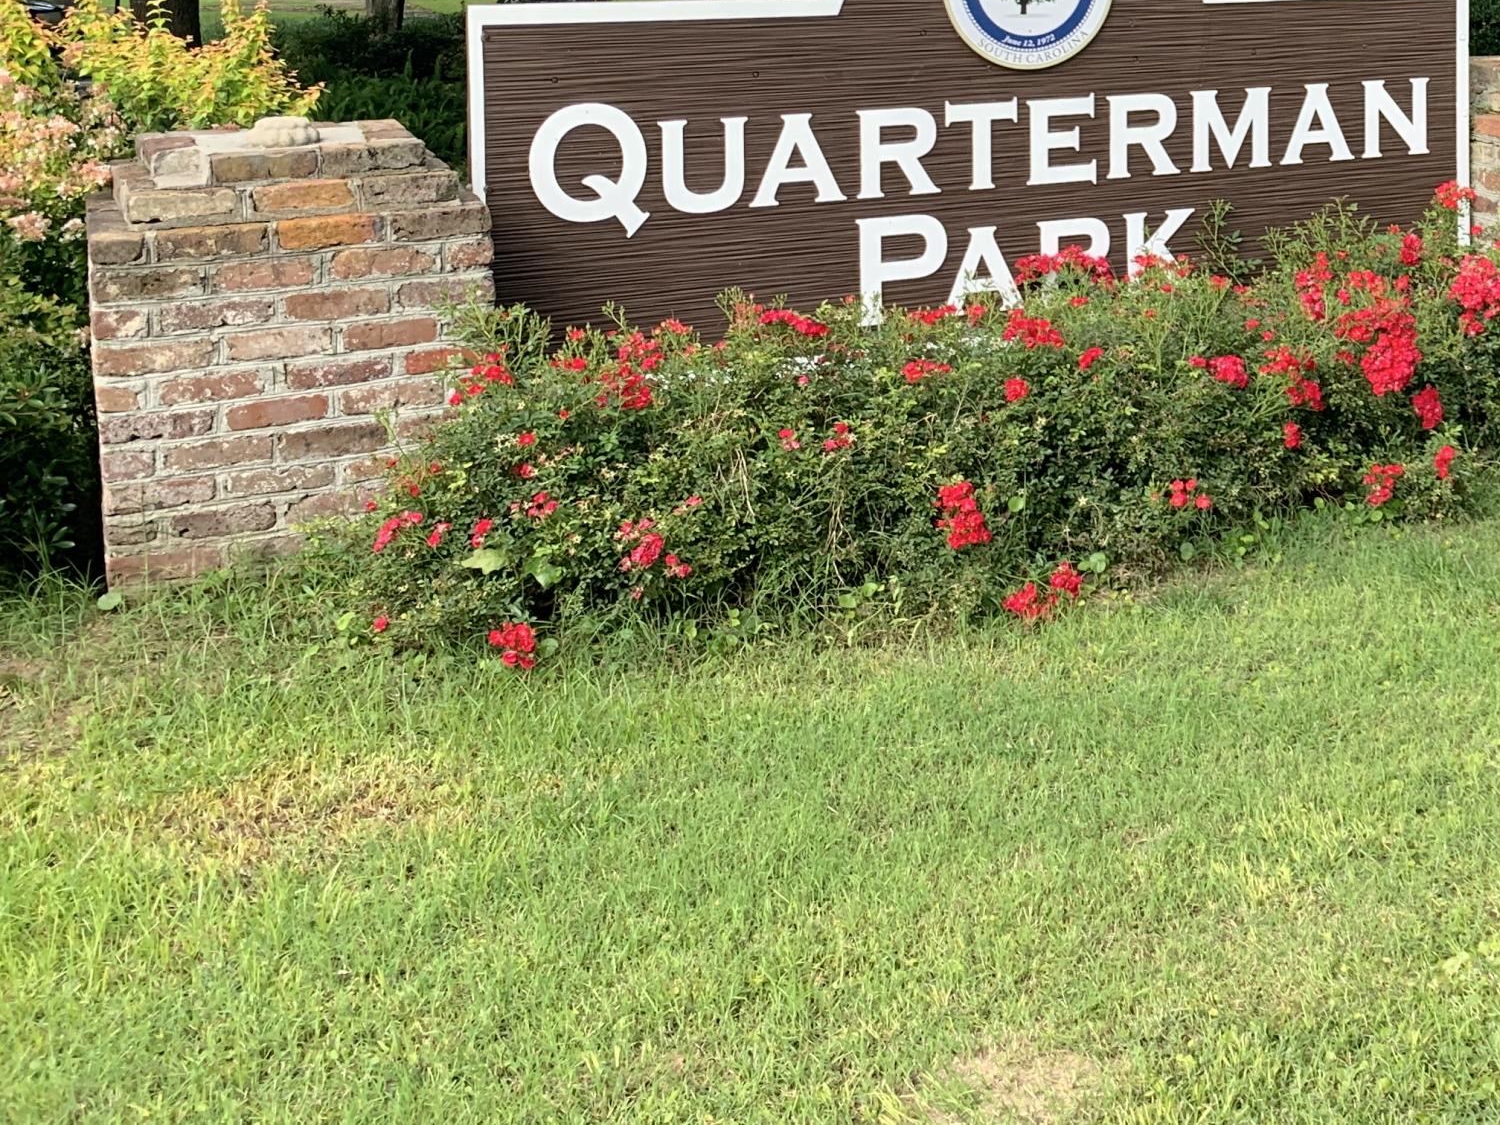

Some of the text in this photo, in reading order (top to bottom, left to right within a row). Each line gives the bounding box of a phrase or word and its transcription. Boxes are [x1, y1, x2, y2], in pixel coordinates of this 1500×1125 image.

[978, 30, 1088, 63] SOUTH CAROLINA
[1002, 35, 1021, 46] June
[1037, 34, 1056, 46] 1972
[529, 77, 1430, 238] QUARTERMAN
